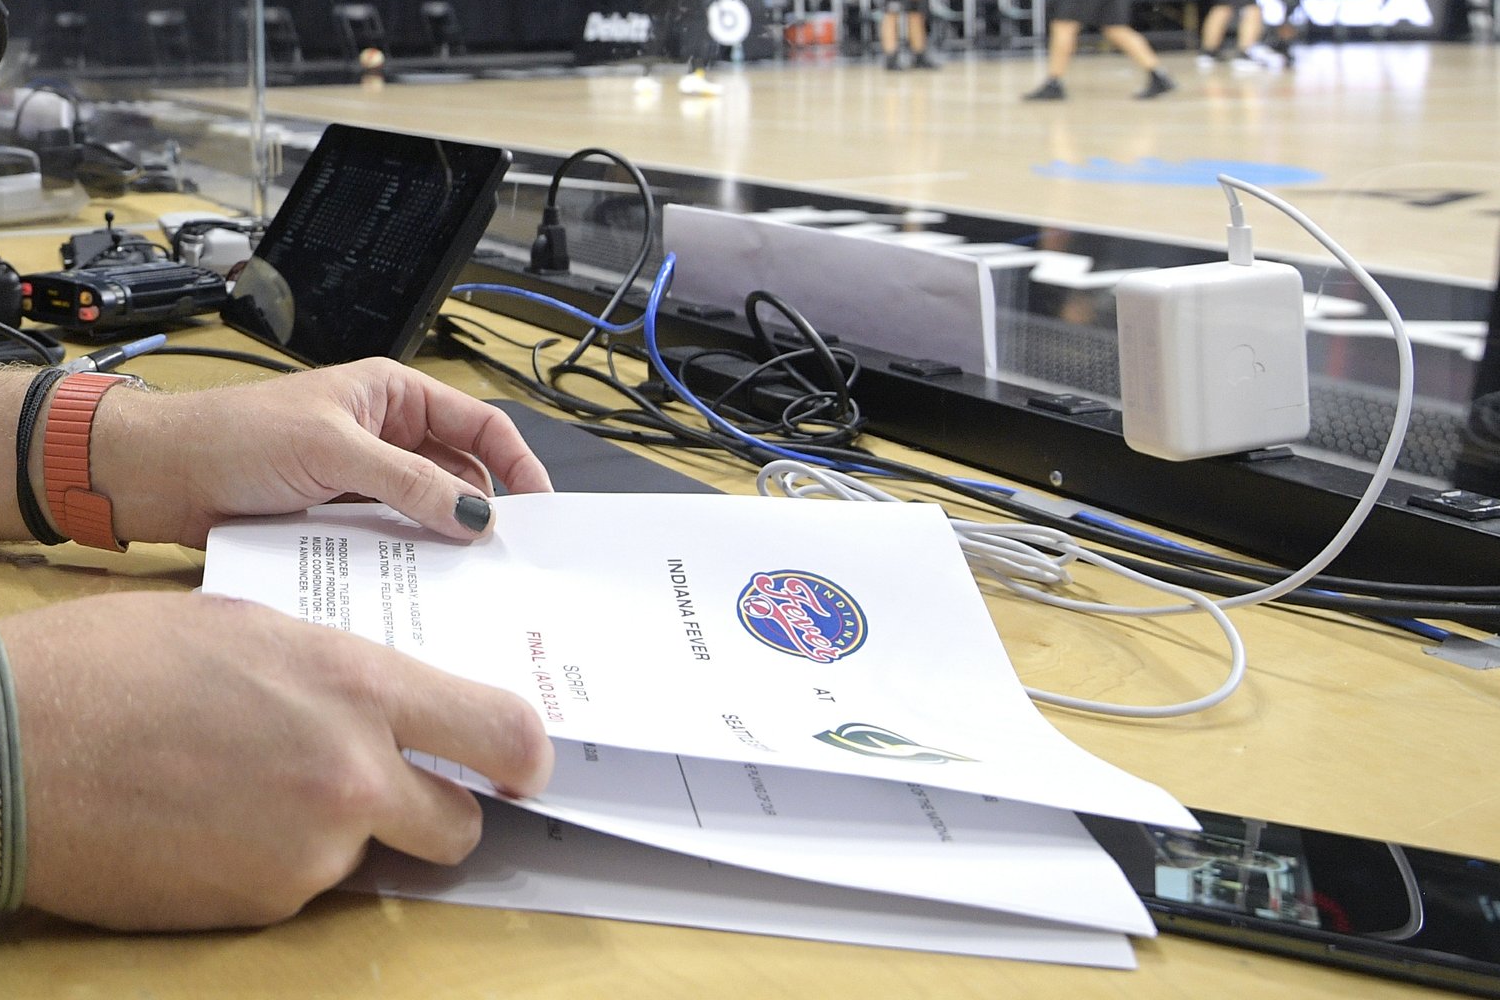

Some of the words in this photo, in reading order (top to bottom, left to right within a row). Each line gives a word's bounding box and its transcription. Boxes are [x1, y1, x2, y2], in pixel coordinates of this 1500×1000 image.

[299, 535, 308, 545] PA
[312, 536, 322, 558] MUSIC
[325, 536, 335, 576] ASSISTANT
[338, 537, 348, 579] PRODUCER:
[392, 542, 401, 560] TIME:
[405, 542, 416, 564] DATE:
[299, 546, 308, 593] ANNOUNCER:
[379, 540, 389, 579] LOCATION:
[312, 559, 322, 614] COORDINATOR:
[326, 577, 336, 620] PRODUCER:
[339, 582, 349, 605] TYLER
[299, 596, 308, 616] MATT
[667, 558, 695, 618] INDIANA
[683, 621, 711, 662] FEVER
[753, 573, 841, 663] Fever
[813, 583, 855, 647] INDIANA
[526, 630, 547, 662] FINAL
[562, 664, 590, 702] SCRIPT
[812, 686, 837, 704] AT
